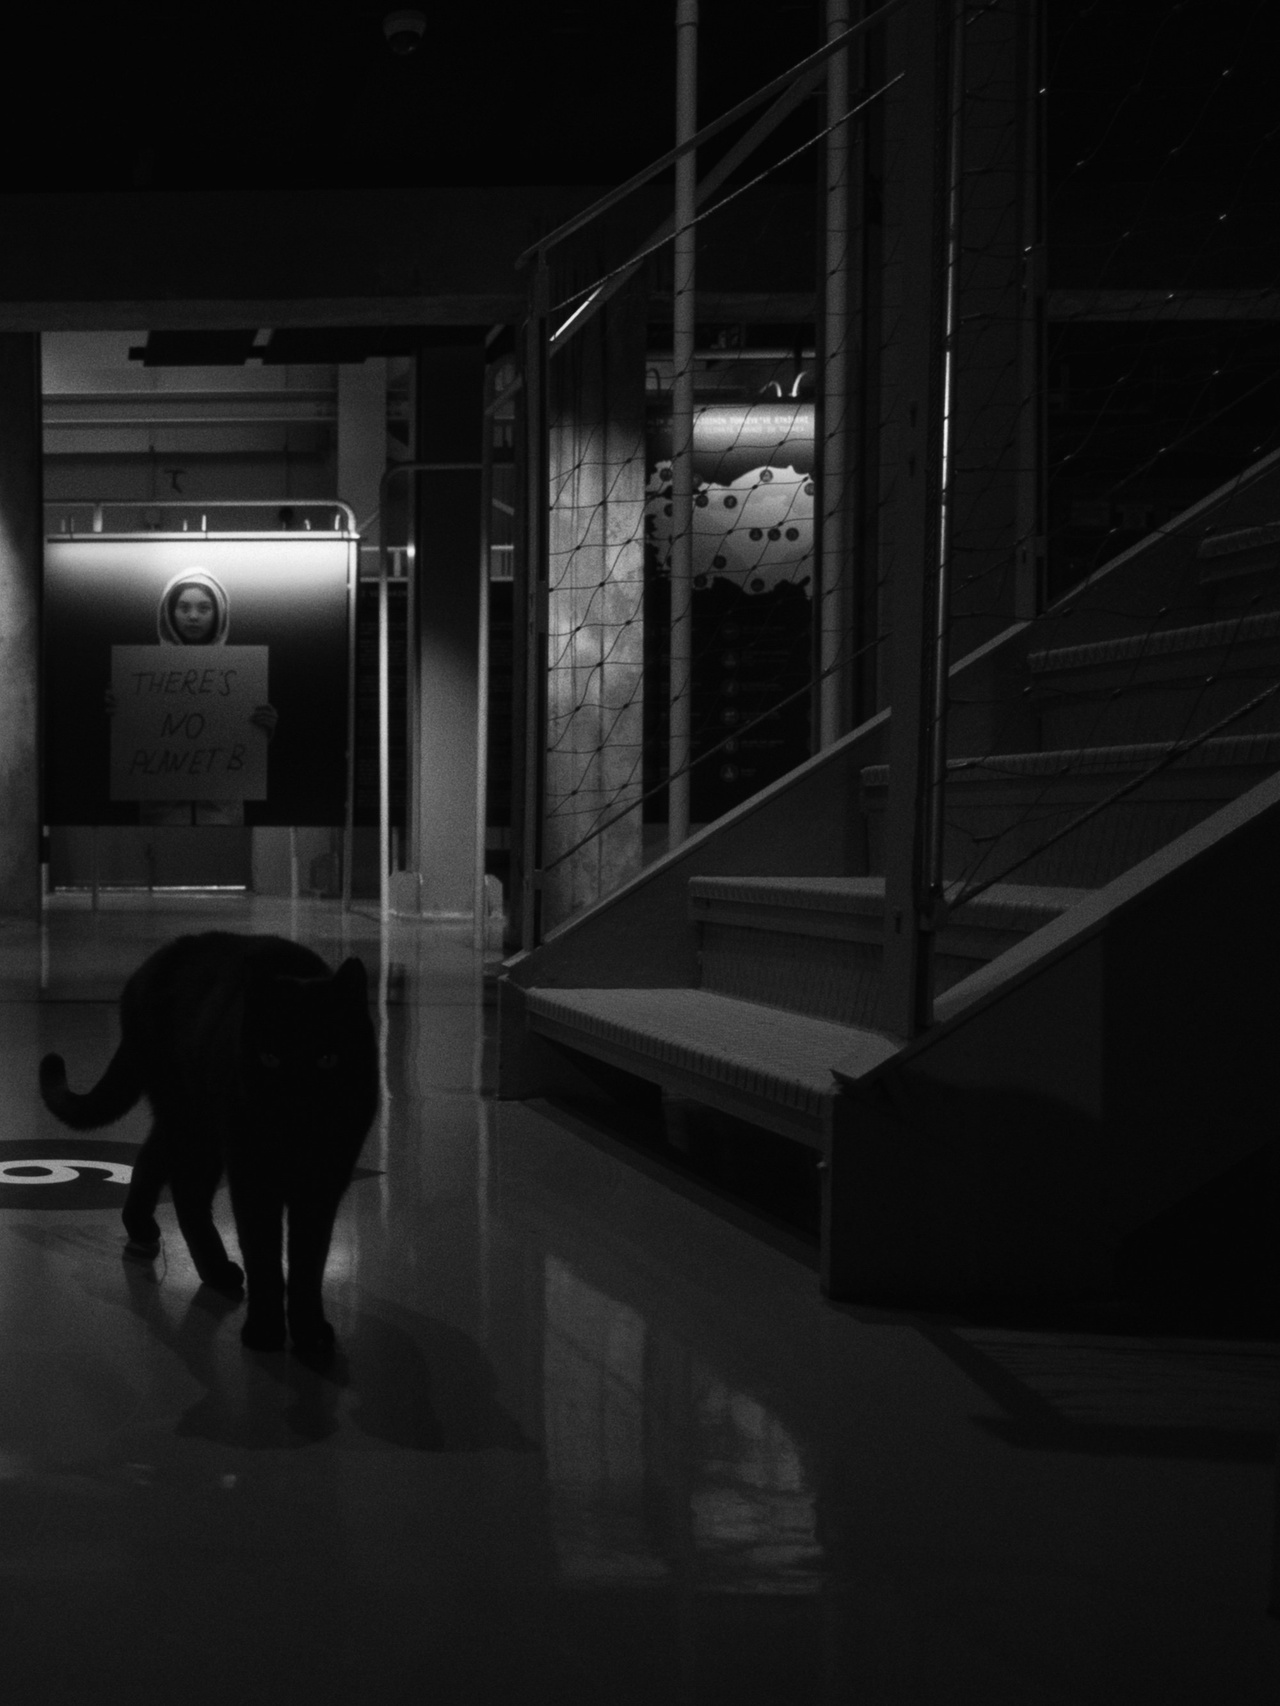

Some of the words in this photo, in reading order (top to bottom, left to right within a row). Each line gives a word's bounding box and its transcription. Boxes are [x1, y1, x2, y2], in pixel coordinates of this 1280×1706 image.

[131, 668, 238, 697] THERE'S
[160, 712, 206, 740] NO
[128, 747, 225, 776] PLANET
[227, 743, 247, 772] B
